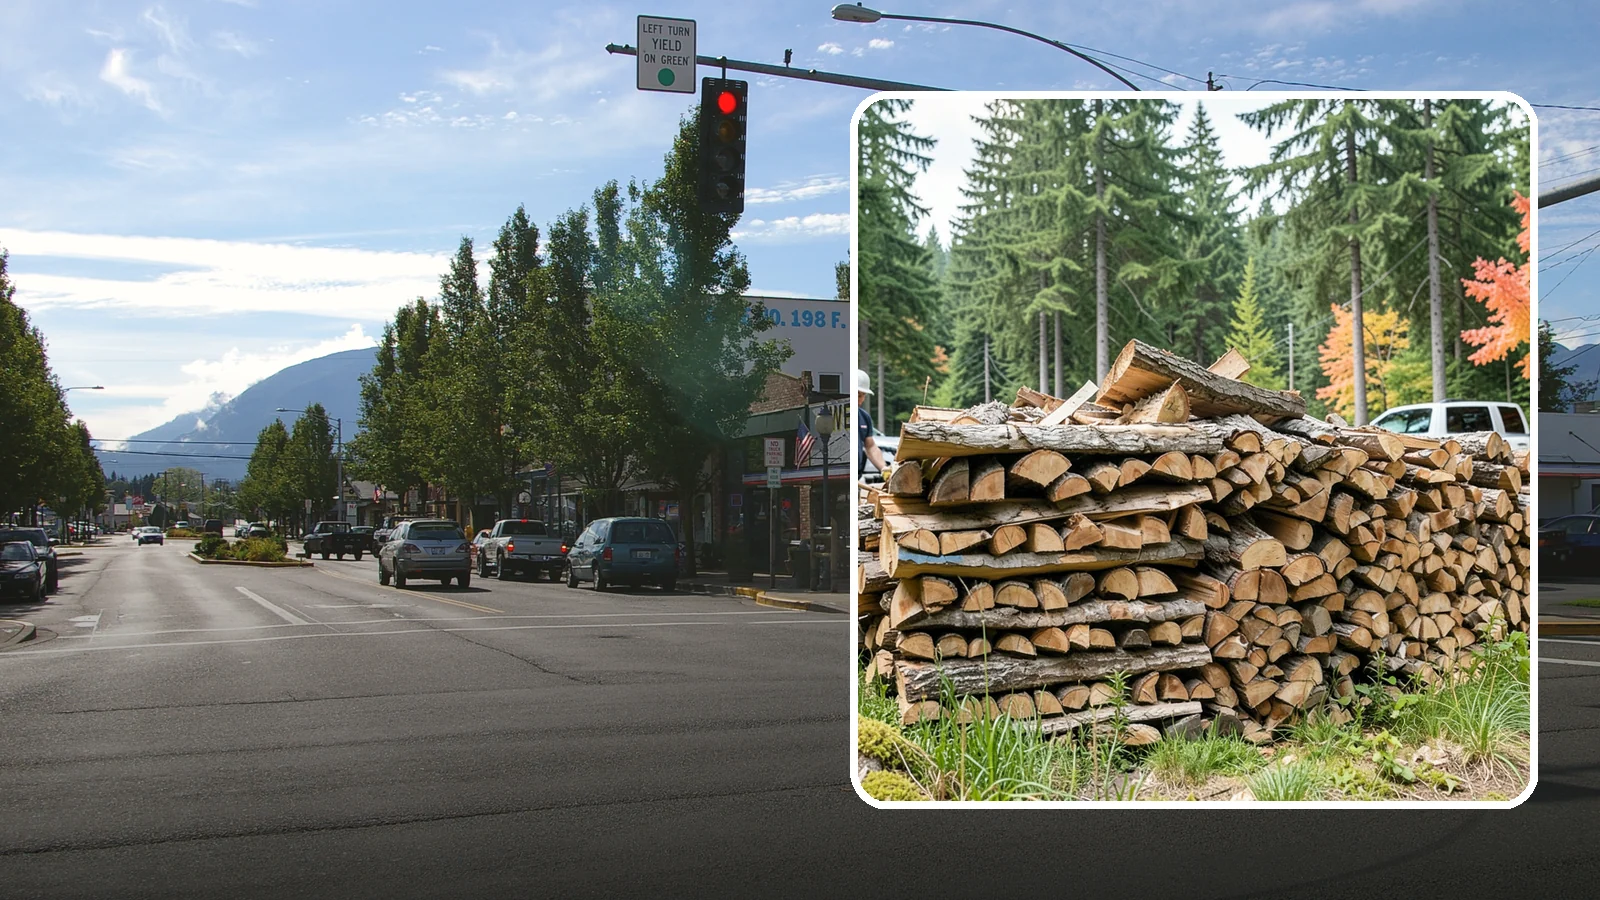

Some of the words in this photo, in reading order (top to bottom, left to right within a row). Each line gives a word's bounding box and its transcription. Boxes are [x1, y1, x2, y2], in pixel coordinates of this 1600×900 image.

[643, 24, 663, 34] LEFT
[668, 26, 690, 36] TURN
[652, 38, 682, 51] YIELD
[644, 53, 656, 63] ON
[661, 55, 688, 66] GREEN
[791, 309, 827, 328] 198
[831, 311, 846, 329] F.
